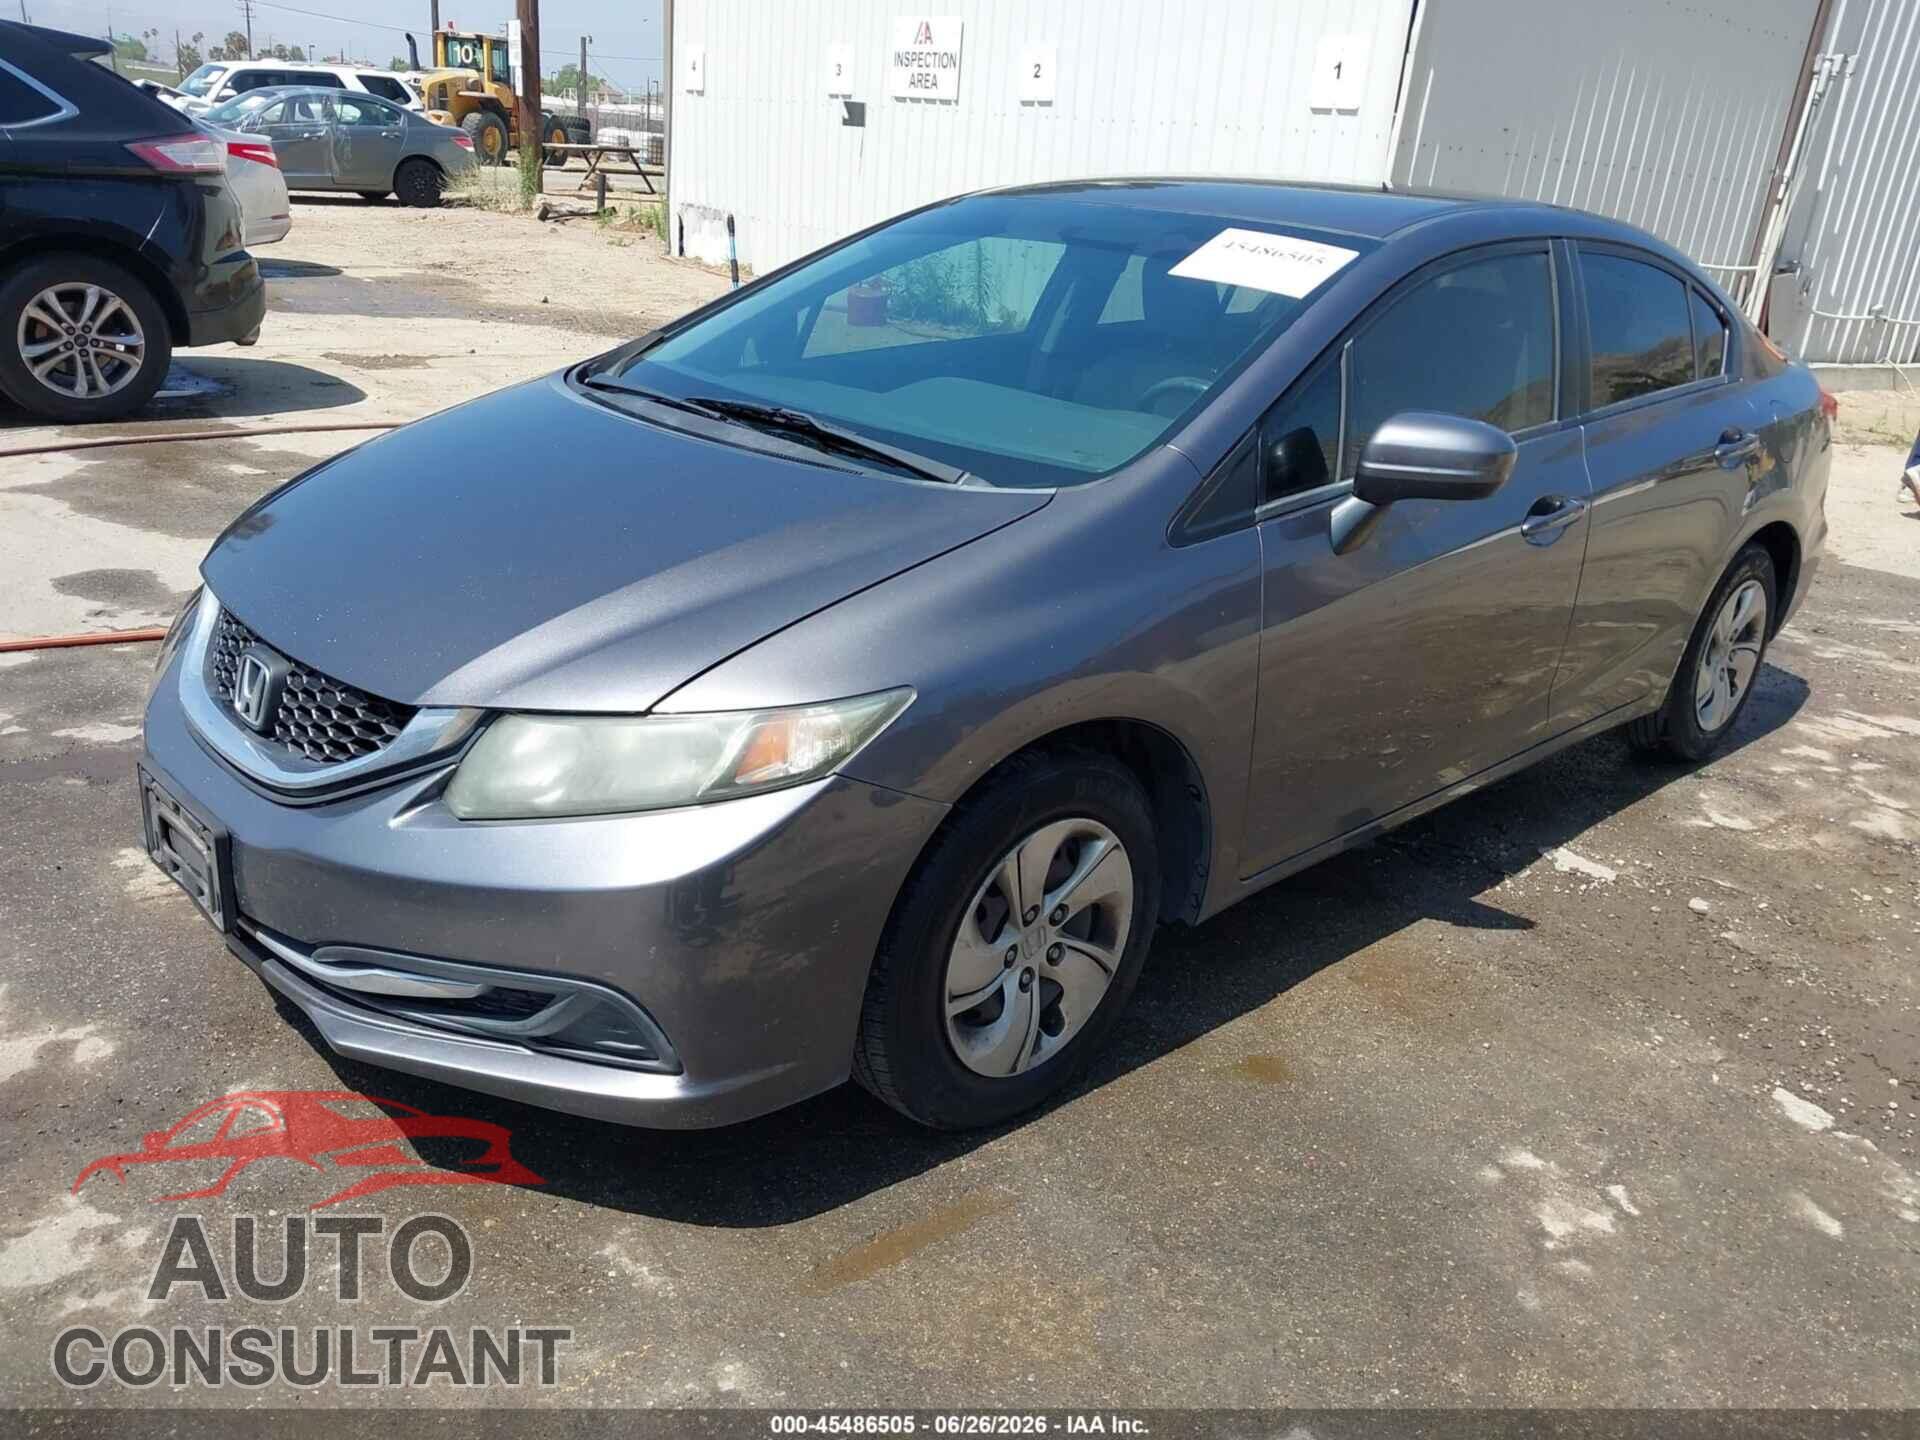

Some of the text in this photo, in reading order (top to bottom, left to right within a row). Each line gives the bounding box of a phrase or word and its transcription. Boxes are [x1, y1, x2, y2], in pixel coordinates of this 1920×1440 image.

[453, 44, 473, 64] 10
[894, 51, 957, 69] INSPECTION
[834, 62, 843, 77] 3
[1032, 62, 1042, 79] 2
[1332, 60, 1343, 80] 1
[908, 73, 938, 90] AREA
